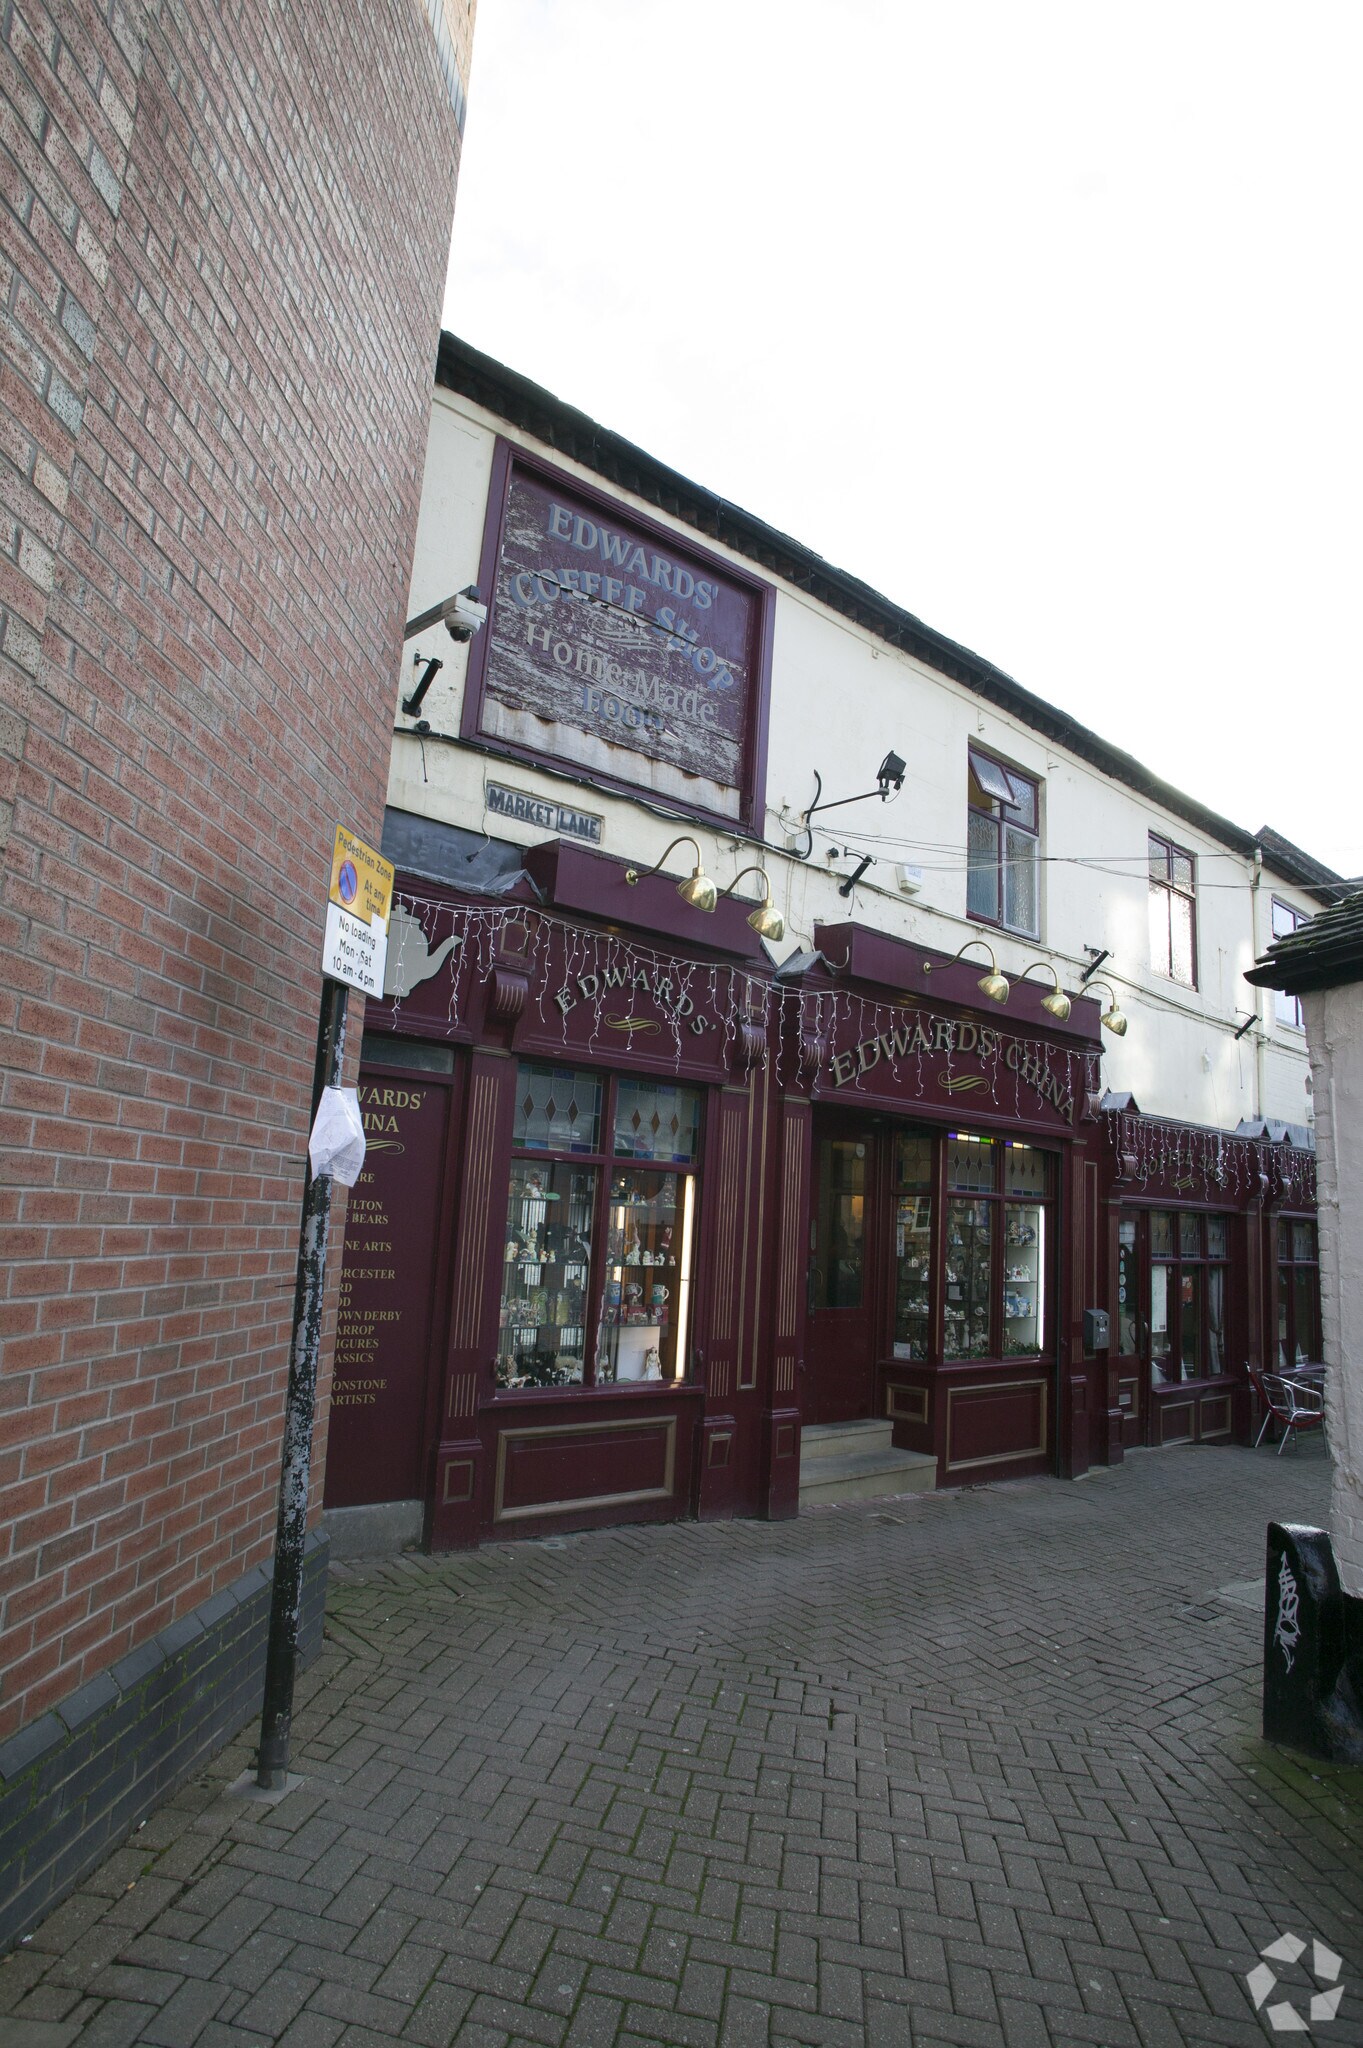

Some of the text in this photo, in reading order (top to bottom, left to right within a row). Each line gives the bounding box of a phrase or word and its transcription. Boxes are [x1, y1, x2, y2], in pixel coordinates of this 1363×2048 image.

[546, 503, 719, 610] EDWARDS'
[509, 567, 734, 691] COFFEE SHOP
[488, 788, 597, 838] MARKET LANE
[338, 831, 391, 881] Pedestrian Zone
[364, 879, 385, 905] At any
[366, 897, 380, 915] time
[339, 915, 376, 950] No loading
[333, 956, 341, 971] 10
[339, 938, 355, 958] Mon
[360, 950, 371, 967] Sat
[554, 966, 717, 1035] EDWARDS'
[1006, 1043, 1074, 1126] CHINA
[360, 1112, 399, 1133] INA
[352, 1213, 388, 1224] BEARS
[363, 1241, 391, 1252] ARTS
[341, 1268, 395, 1279] RCESTER
[364, 1311, 403, 1320] DERBY
